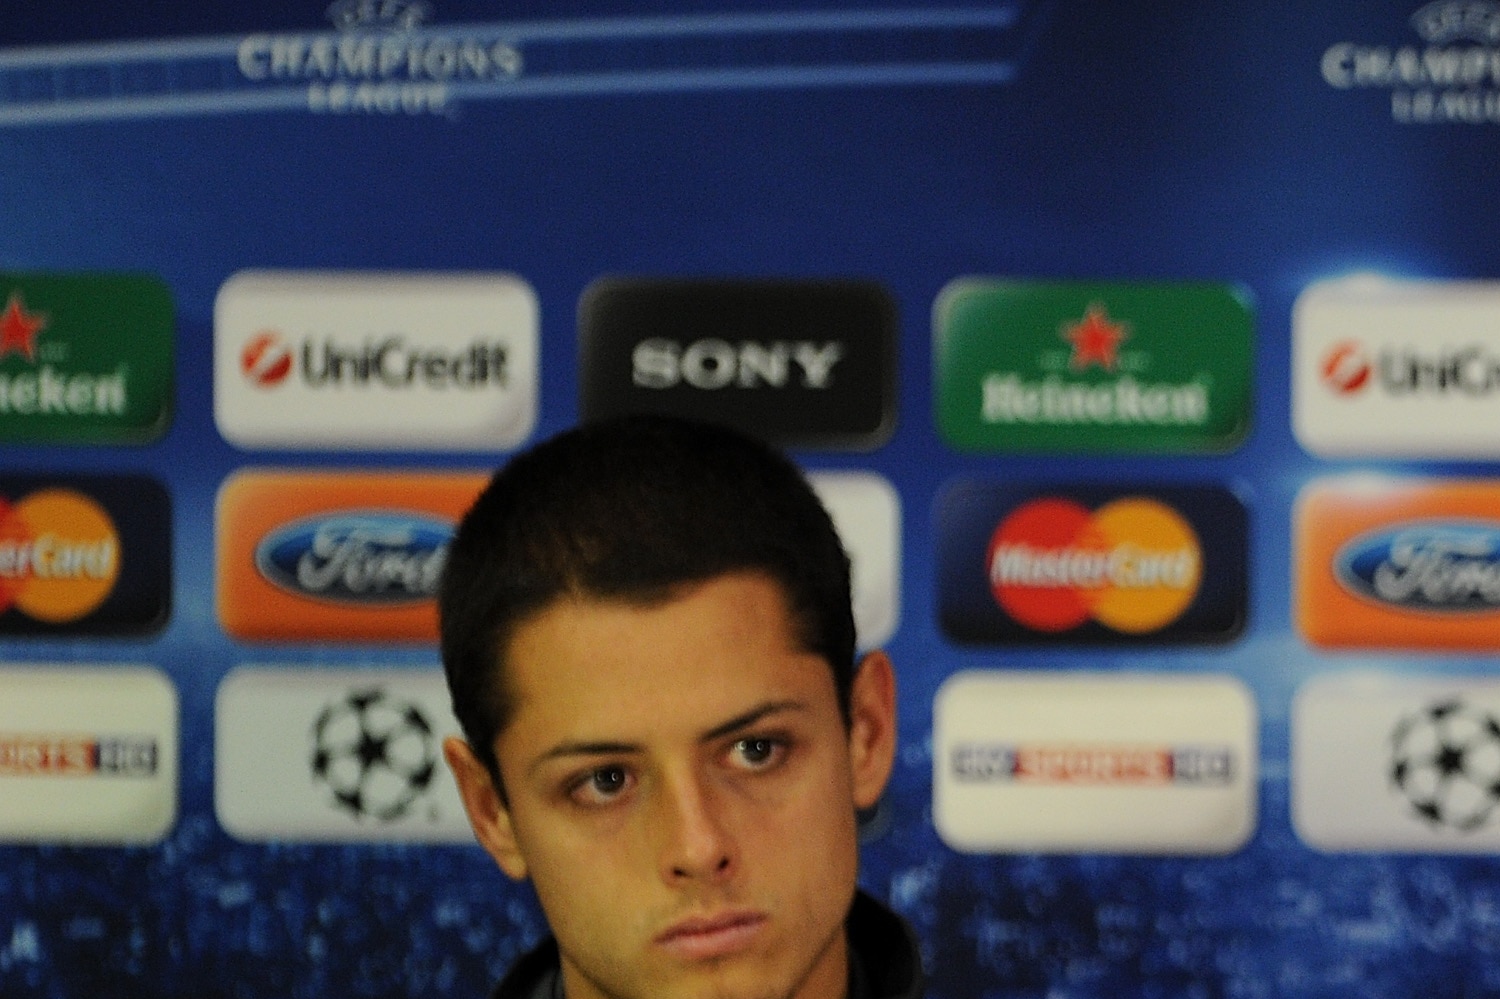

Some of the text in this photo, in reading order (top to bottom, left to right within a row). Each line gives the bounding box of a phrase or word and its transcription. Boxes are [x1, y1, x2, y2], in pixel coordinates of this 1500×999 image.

[236, 35, 524, 81] CHAMPIONS
[301, 339, 509, 390] UniCredit
[632, 337, 842, 390] SONY
[980, 371, 1211, 425] Heineken
[989, 541, 1198, 590] MasterCard
